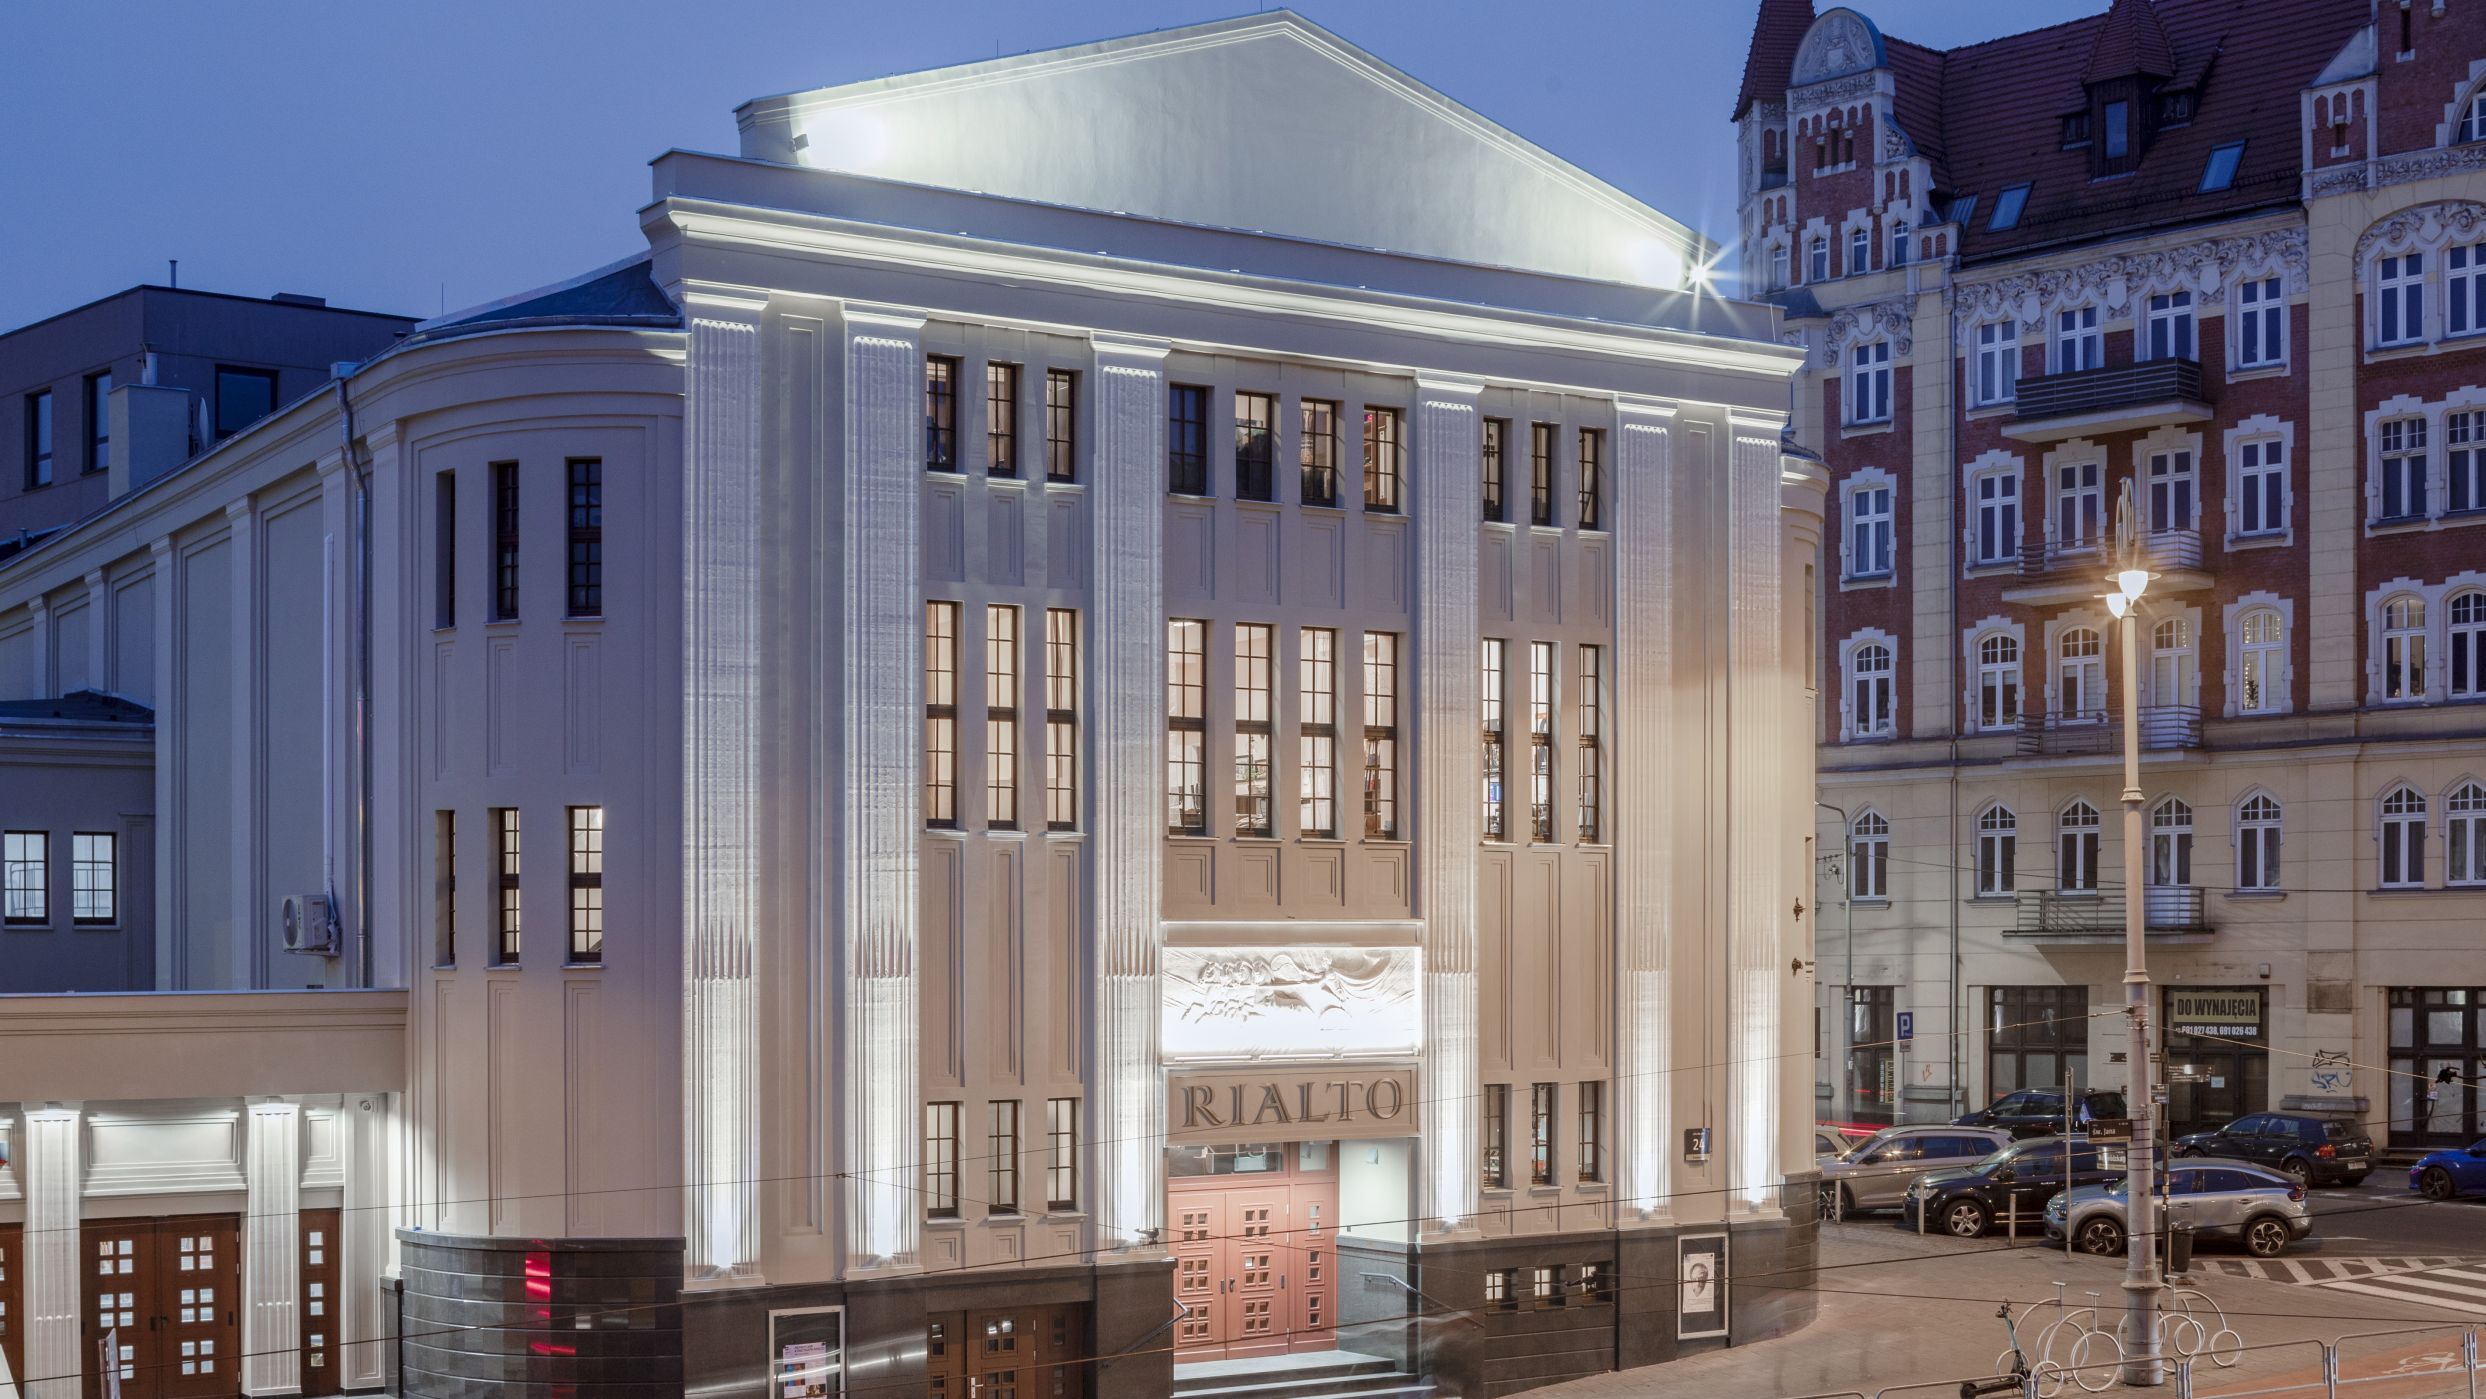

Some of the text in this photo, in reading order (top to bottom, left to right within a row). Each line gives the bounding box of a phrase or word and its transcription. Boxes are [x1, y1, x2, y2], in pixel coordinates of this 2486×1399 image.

[2177, 998, 2256, 1019] DO WYNAJĘCIA
[1900, 1015, 1910, 1037] P
[2219, 1026, 2231, 1035] 691
[2231, 1026, 2244, 1036] 026
[2244, 1026, 2256, 1036] 438
[1181, 1077, 1403, 1128] RIALTO
[2103, 1127, 2116, 1136] Jana
[1693, 1138, 1705, 1151] 24
